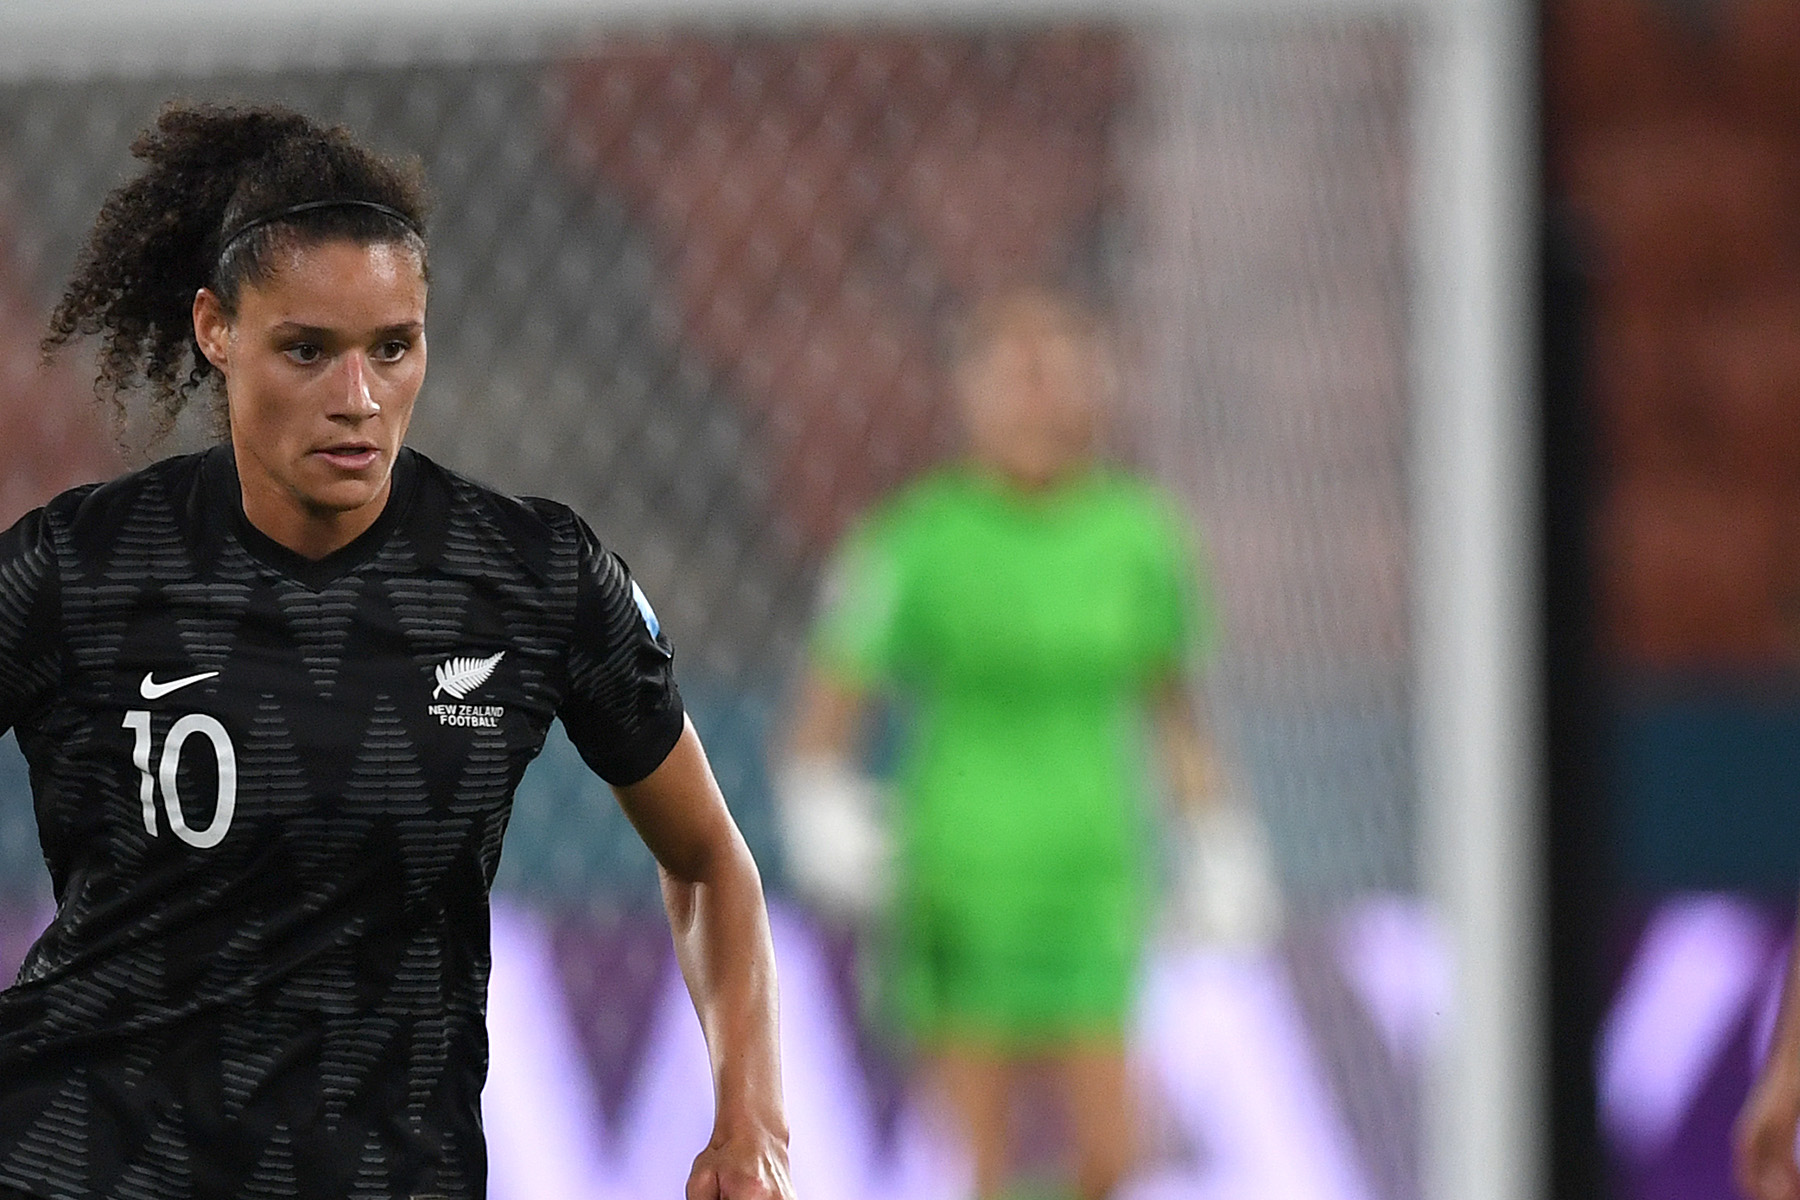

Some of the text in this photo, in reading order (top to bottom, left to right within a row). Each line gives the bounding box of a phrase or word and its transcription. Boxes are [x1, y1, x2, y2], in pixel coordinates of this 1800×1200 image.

[427, 704, 504, 718] NEW ZEALAND
[440, 714, 498, 728] FOOTBALL
[121, 710, 237, 849] 10
